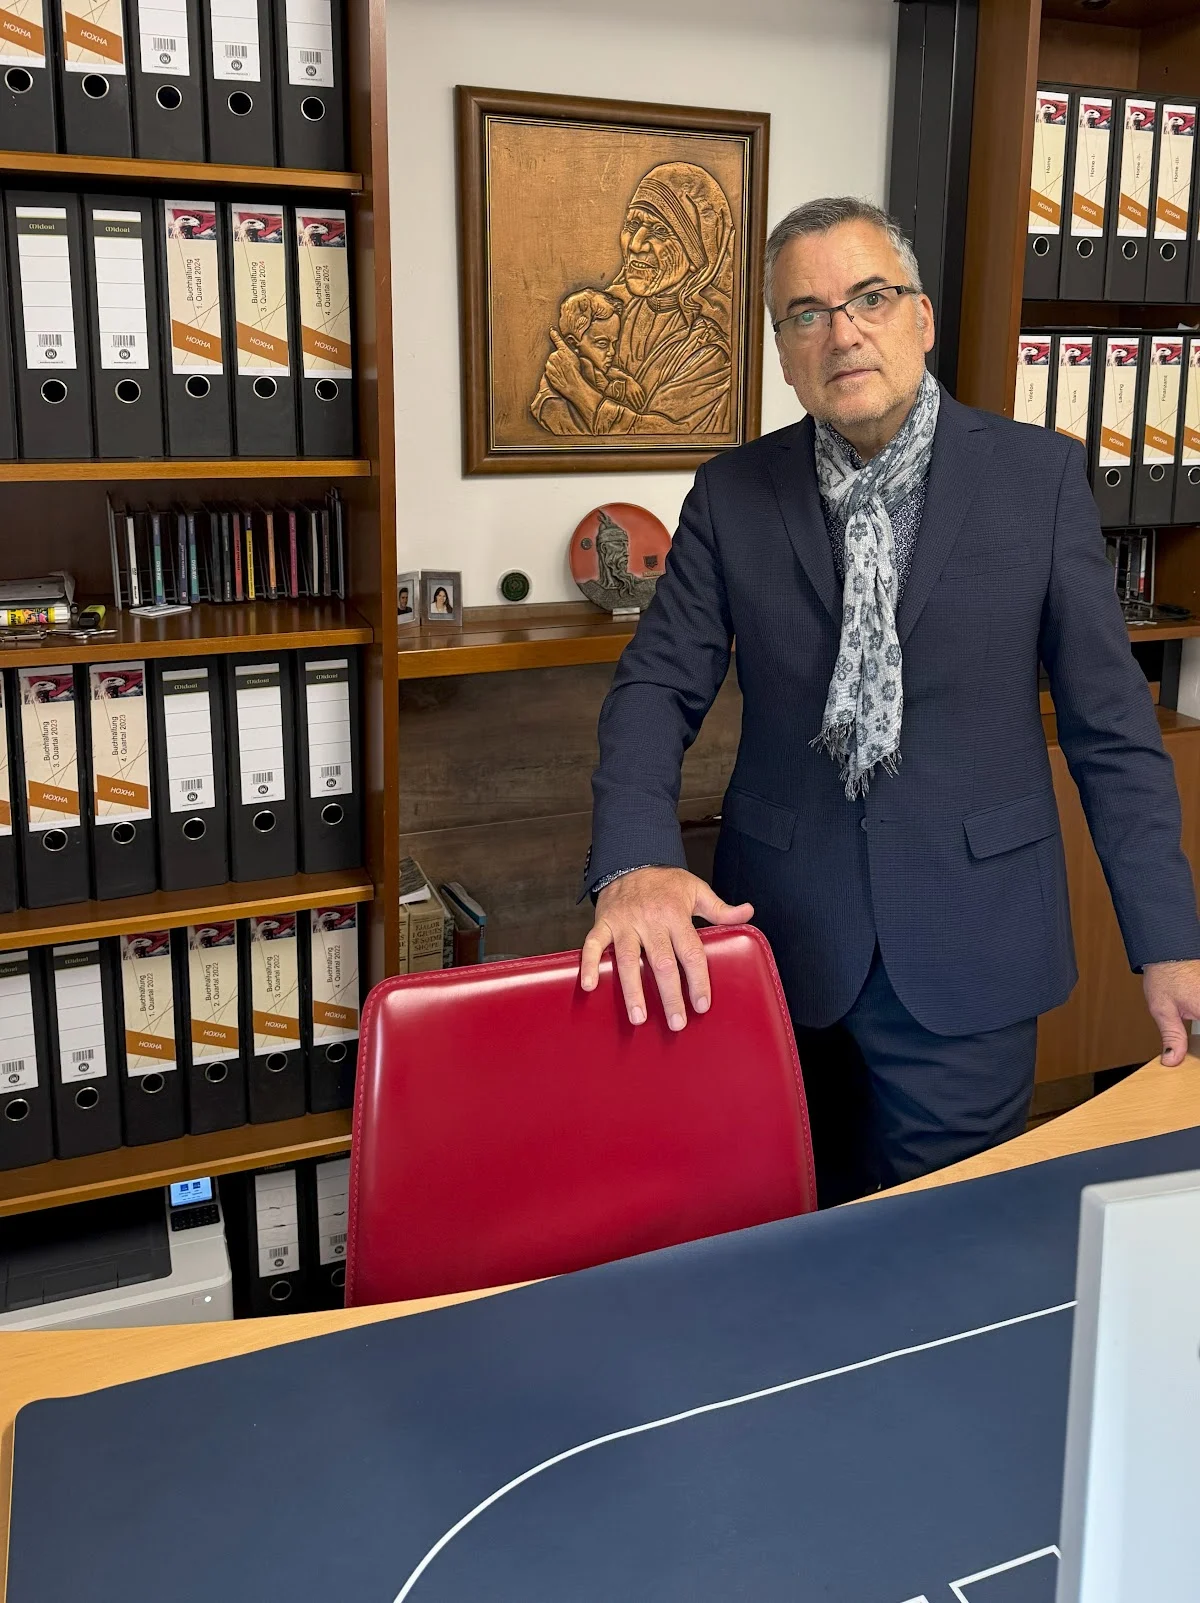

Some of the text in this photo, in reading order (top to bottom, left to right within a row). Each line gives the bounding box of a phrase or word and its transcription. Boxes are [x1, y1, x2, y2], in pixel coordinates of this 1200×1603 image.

[3, 21, 32, 39] HOXHA
[80, 29, 108, 46] HOXHA
[186, 335, 211, 349] HOXHA
[250, 336, 274, 351] HOXHA
[314, 340, 338, 354] HOXHA
[110, 787, 135, 797] HOXHA
[43, 793, 68, 803] HOXHA
[325, 1011, 347, 1020] HOXHA
[265, 1021, 288, 1030] HOXHA
[203, 1030, 226, 1039] HOXHA
[138, 1041, 162, 1050] HOXHA
